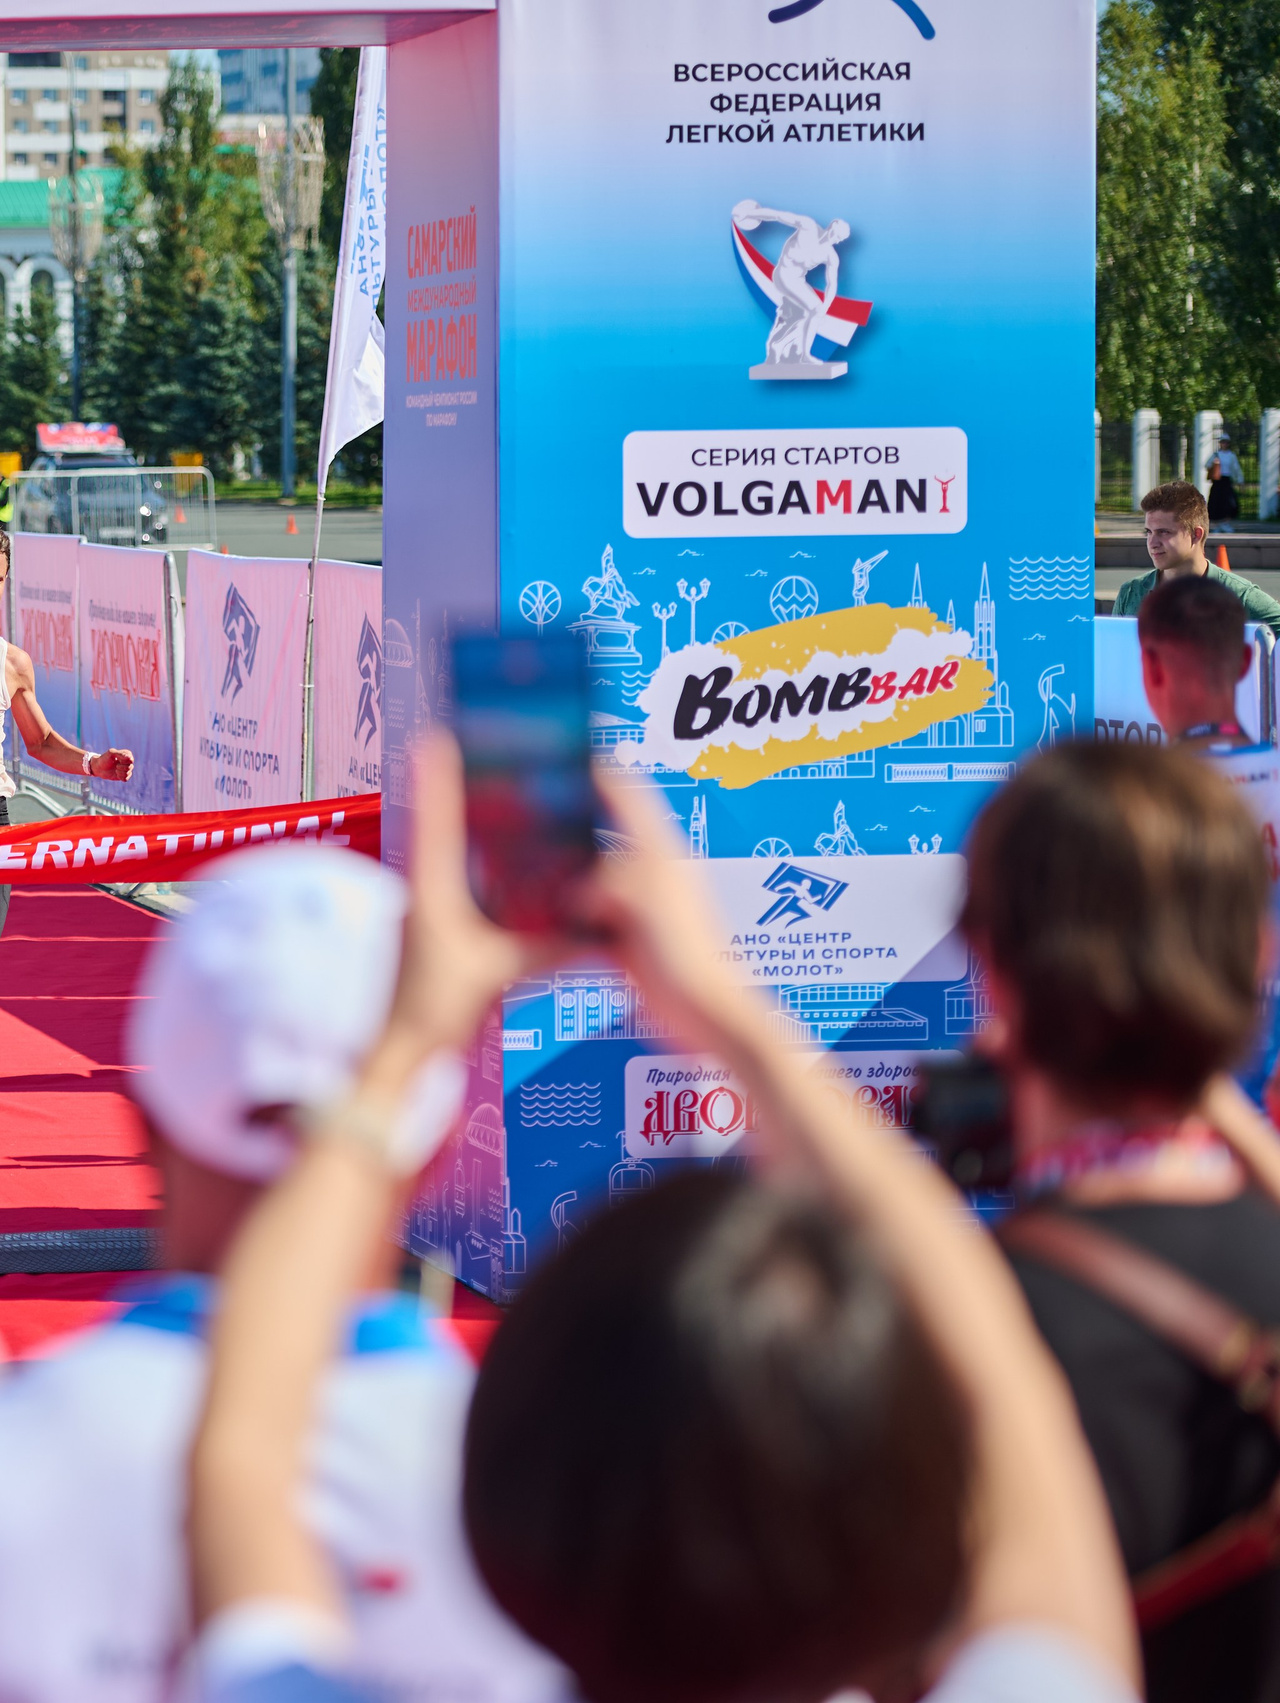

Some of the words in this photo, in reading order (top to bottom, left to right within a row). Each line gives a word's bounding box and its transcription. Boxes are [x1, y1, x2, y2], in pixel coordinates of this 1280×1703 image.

[674, 58, 911, 82] ВСЕРОССИЙСКАЯ
[710, 93, 881, 115] ФЕДЕРАЦИЯ
[666, 119, 774, 143] ЛЕГКОЙ
[783, 123, 924, 142] АТЛЕТИКИ
[407, 205, 477, 279] САМАРСКИЙ
[407, 275, 477, 315] МЕЖДУНАРОДНЫЙ
[406, 313, 478, 383] МАРАФОН
[691, 448, 775, 466] СЕРИЯ
[784, 446, 900, 465] СТАРТОВ
[636, 479, 927, 517] VOLGAMAN
[243, 749, 280, 775] СПОРТА
[730, 934, 770, 946] АНО
[778, 932, 852, 946] «ЦЕНТР
[803, 949, 815, 961] И
[822, 947, 898, 960] СПОРТА
[752, 964, 843, 977] «МОЛОТ»
[646, 1065, 731, 1085] Природная
